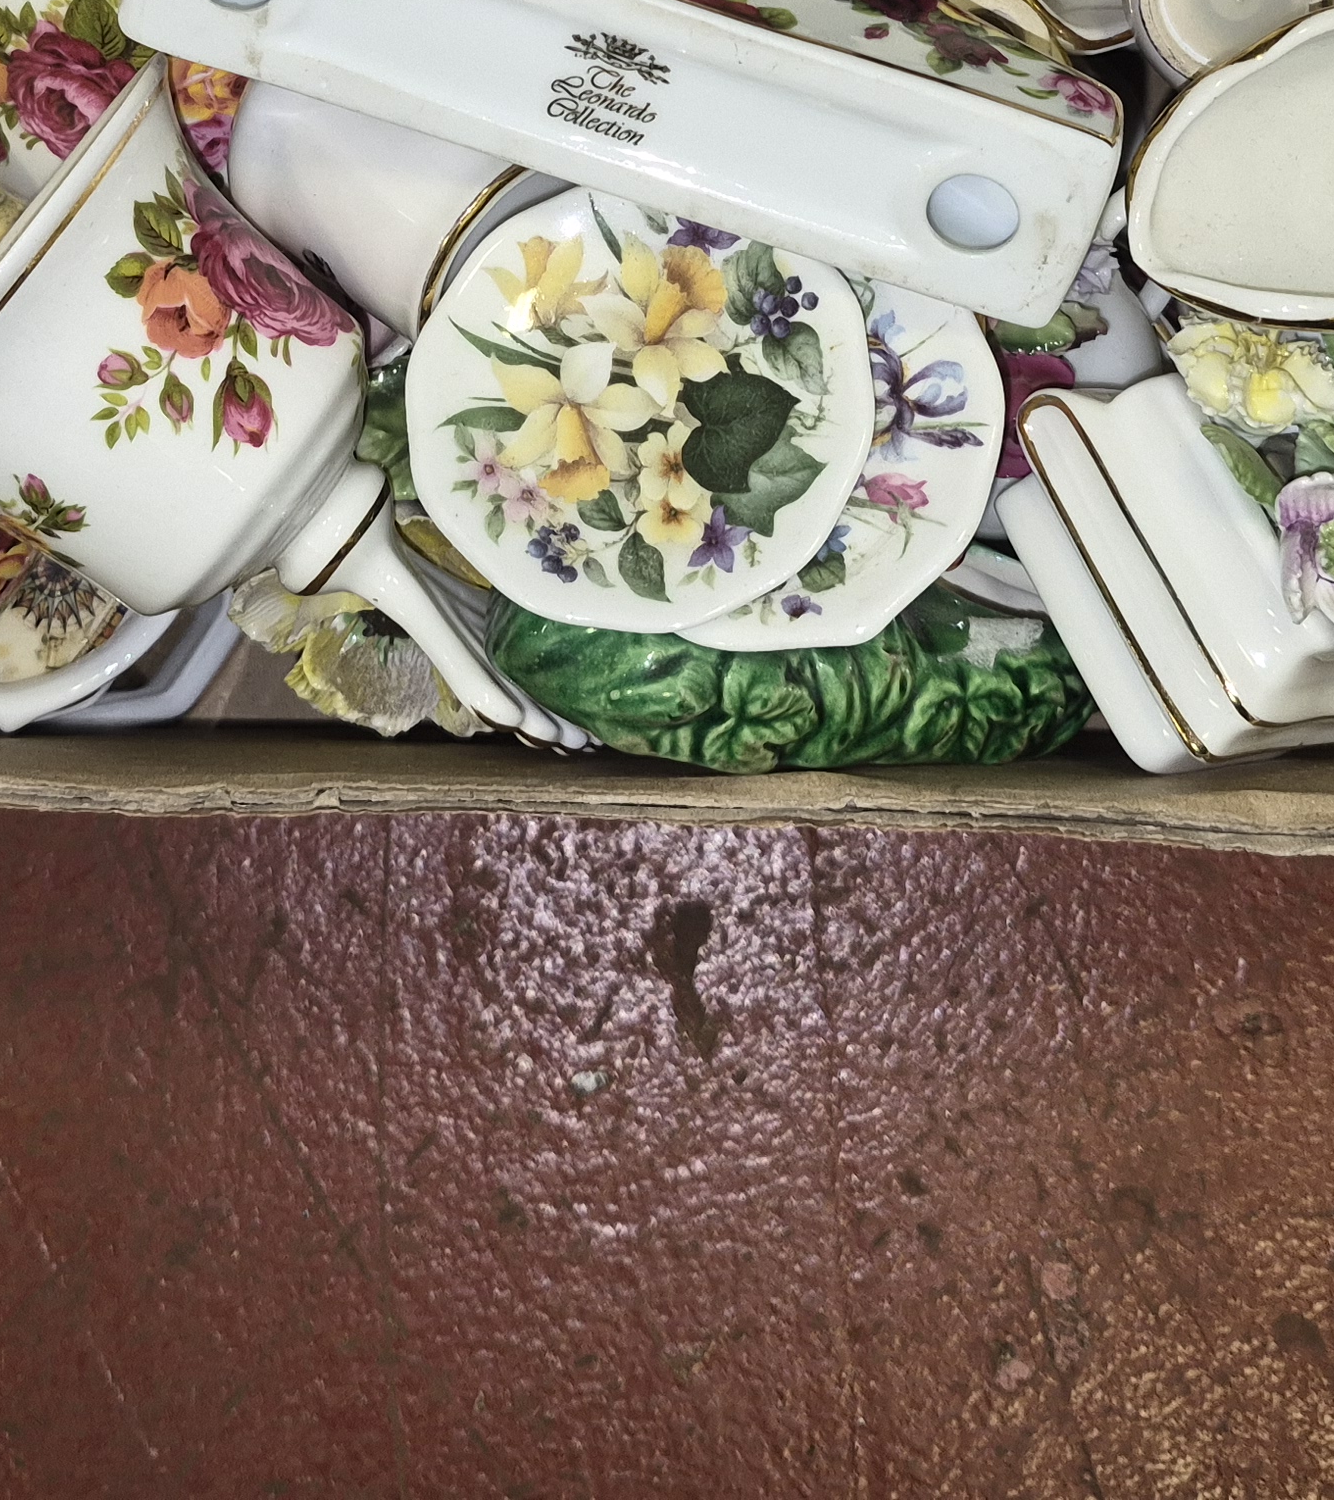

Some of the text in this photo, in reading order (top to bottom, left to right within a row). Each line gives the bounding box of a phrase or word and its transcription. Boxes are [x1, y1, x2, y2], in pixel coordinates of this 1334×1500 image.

[551, 75, 658, 125] Leonardo
[586, 65, 636, 98] The
[546, 97, 645, 147] Collection
